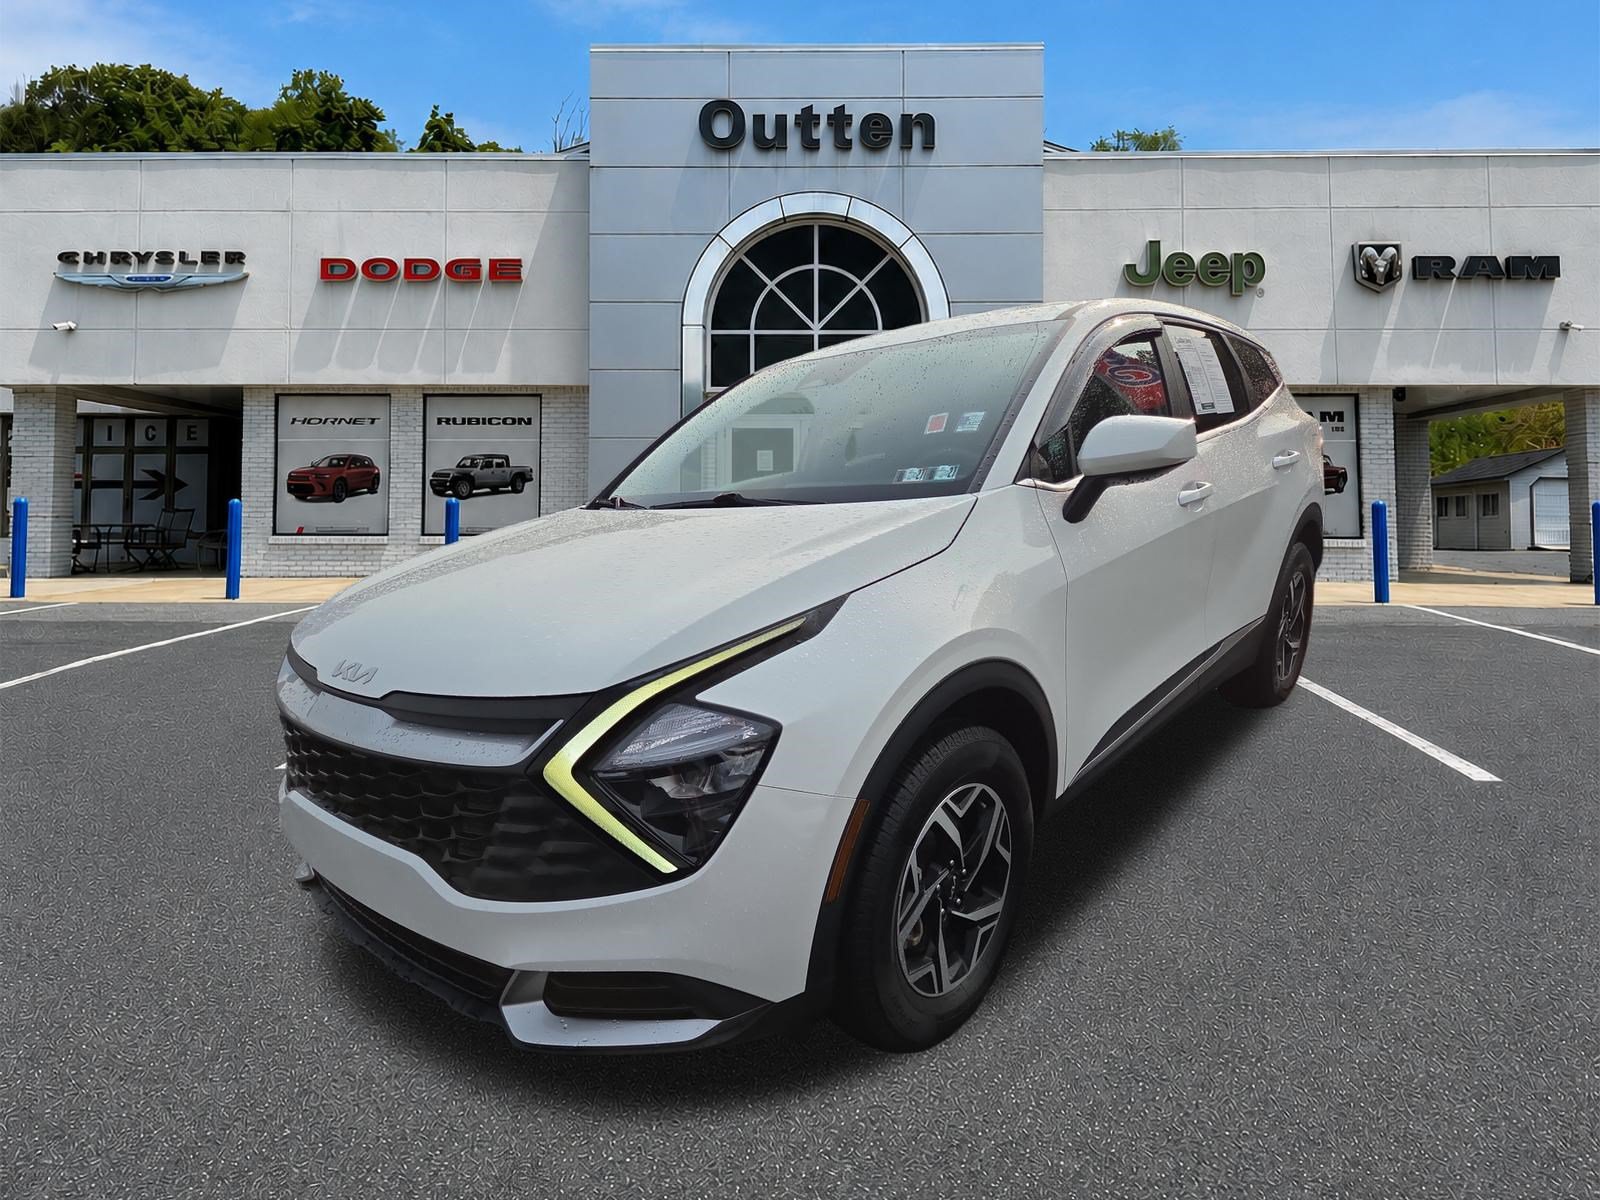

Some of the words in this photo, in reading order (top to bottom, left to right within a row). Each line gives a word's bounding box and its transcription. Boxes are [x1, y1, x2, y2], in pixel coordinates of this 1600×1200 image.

[699, 99, 936, 150] Outten
[57, 251, 246, 266] CHRYSLER
[320, 257, 523, 282] DODGE
[1123, 240, 1266, 296] Jeep
[1411, 255, 1561, 280] RAM
[290, 417, 381, 426] HORNET
[436, 416, 533, 426] RUBICON
[331, 659, 379, 685] KIA
